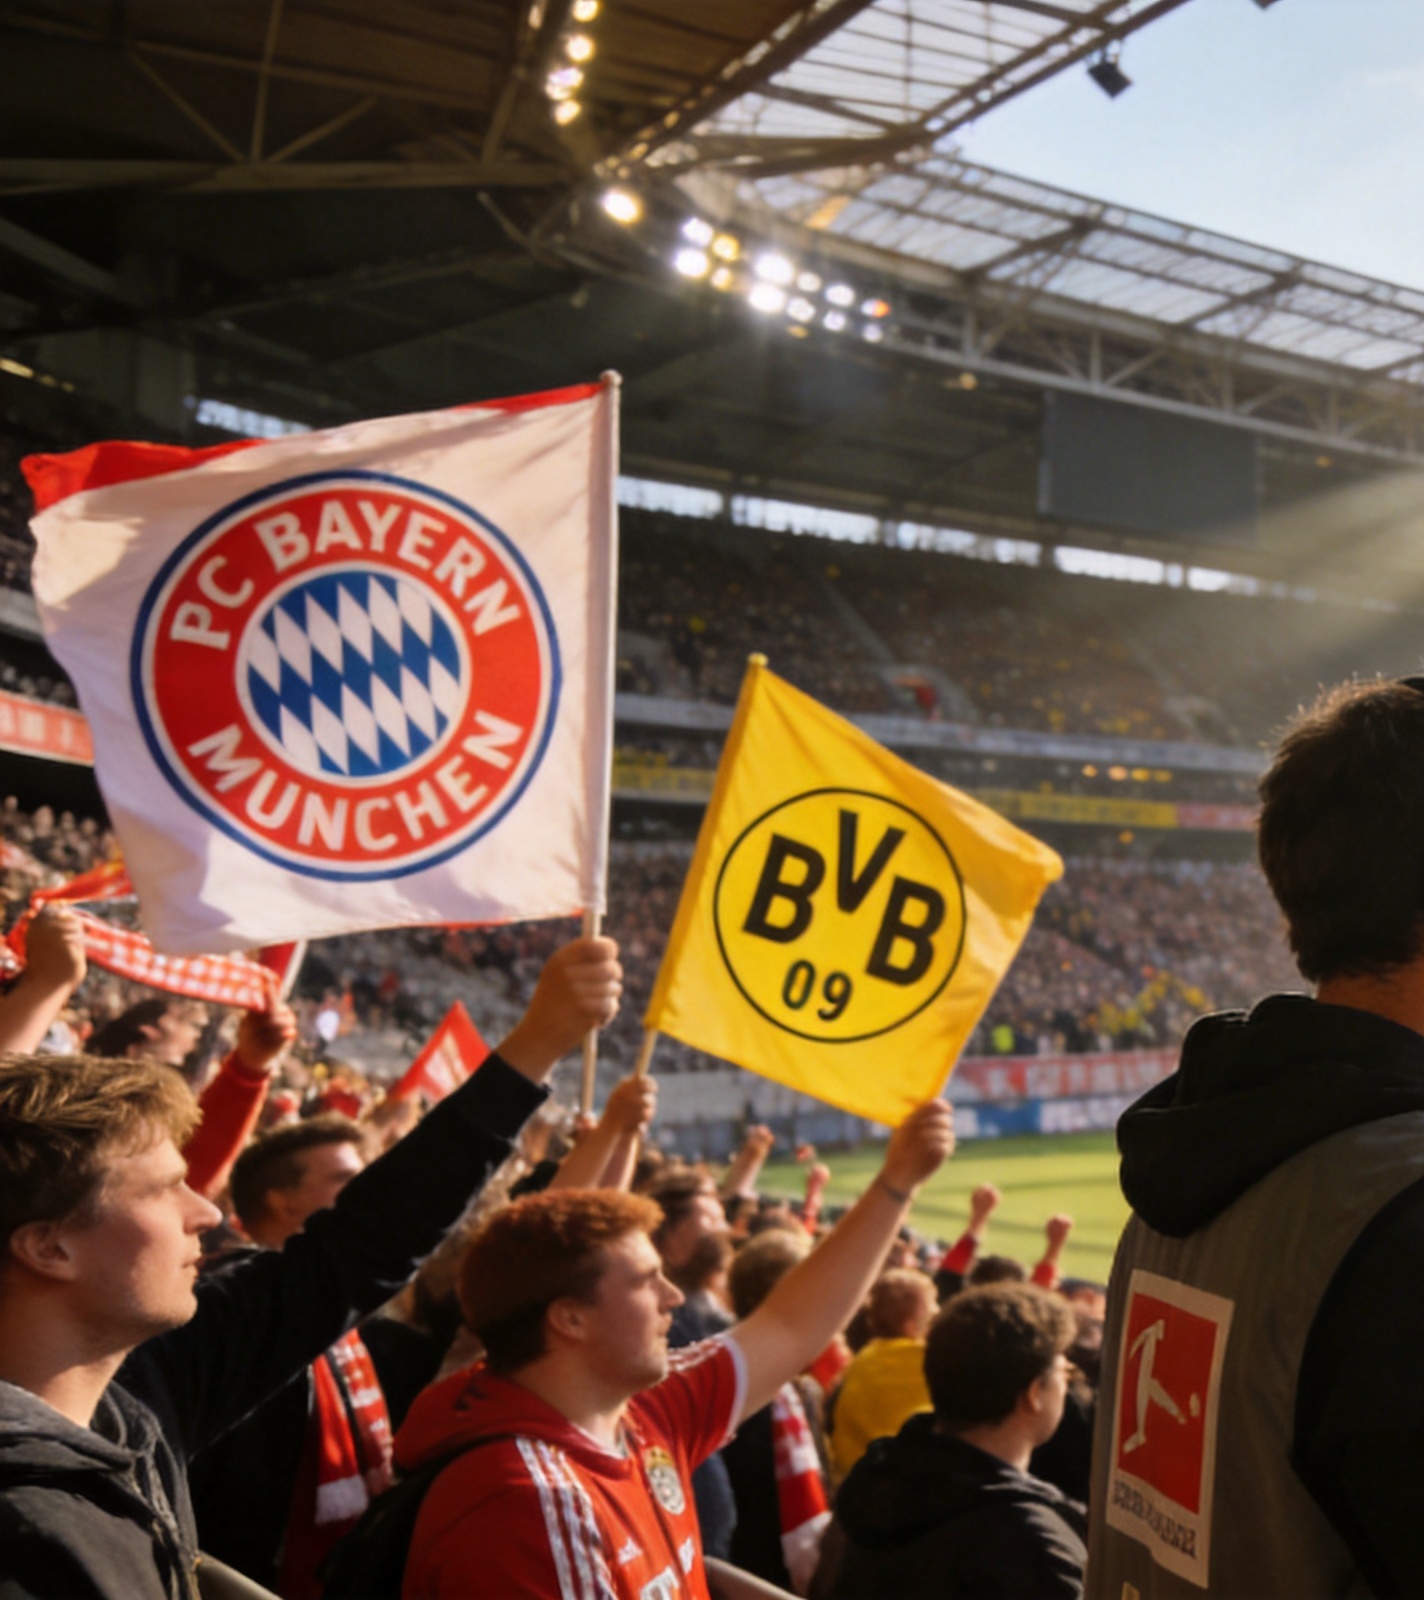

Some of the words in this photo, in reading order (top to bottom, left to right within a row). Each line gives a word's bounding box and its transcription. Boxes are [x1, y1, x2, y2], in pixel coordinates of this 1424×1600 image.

[169, 555, 254, 650] PC
[254, 500, 519, 635] BAYERN
[188, 709, 524, 852] MUNCHEN
[742, 807, 946, 987] BVB
[781, 959, 853, 1022] 09
